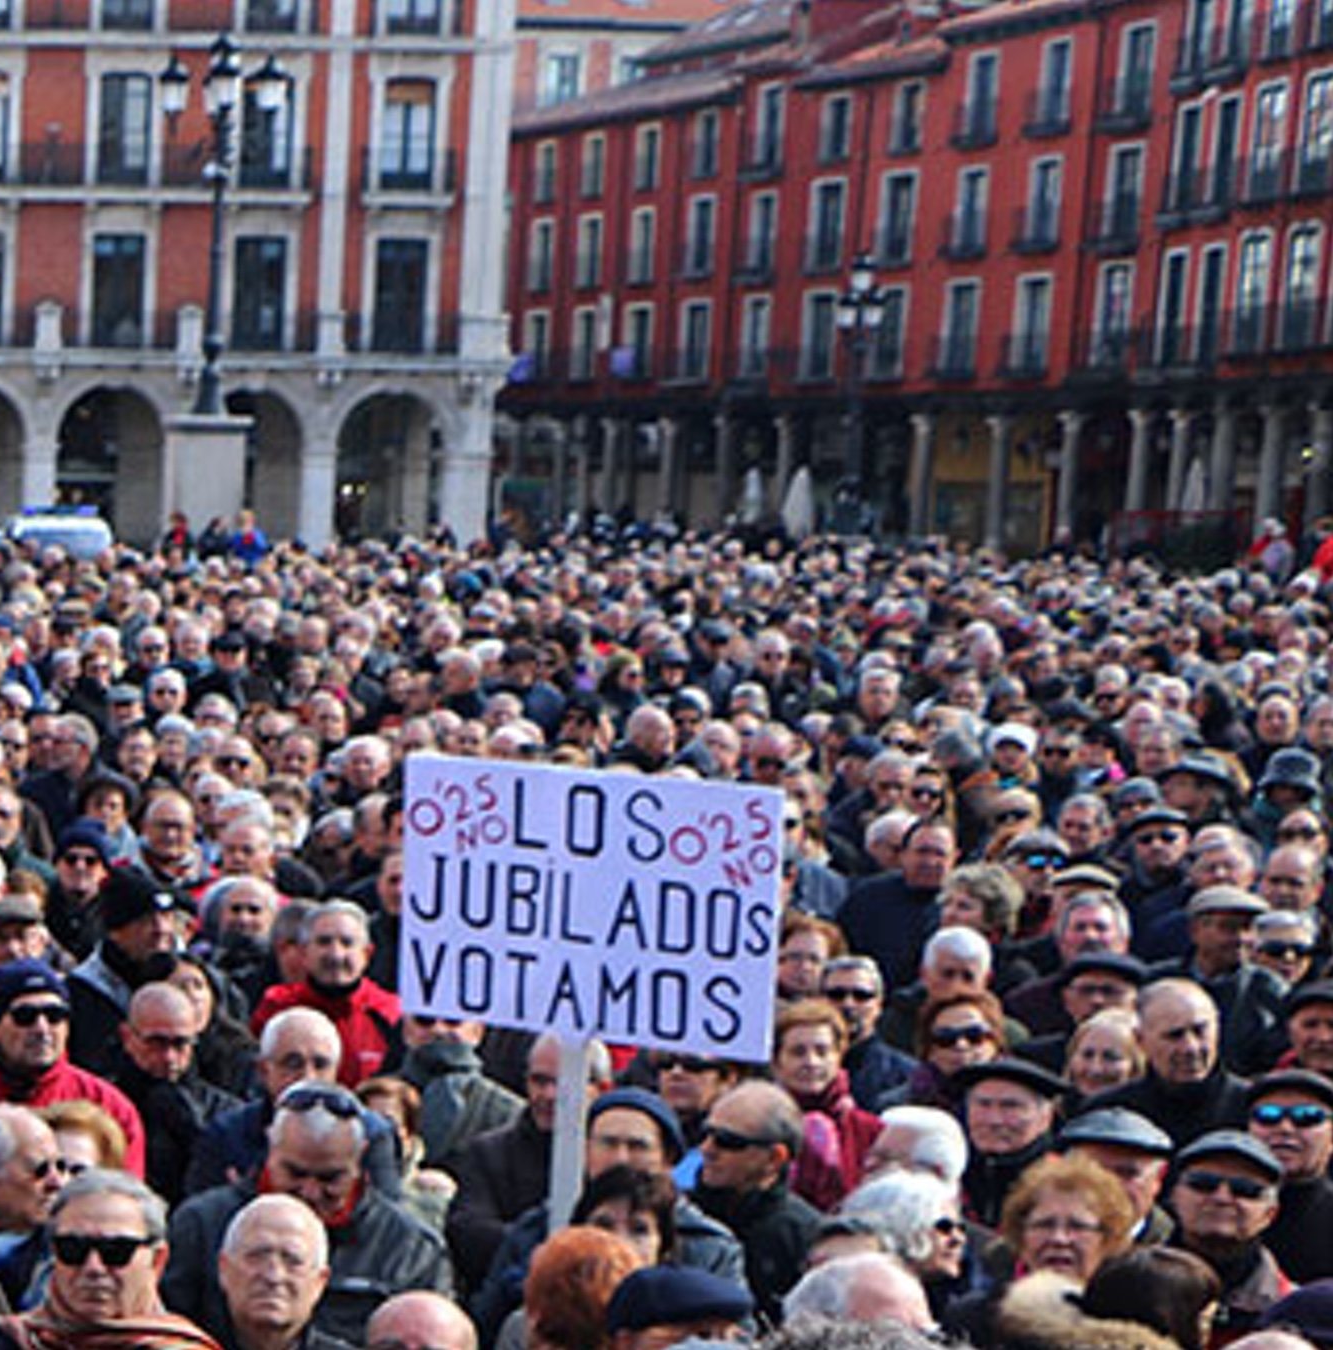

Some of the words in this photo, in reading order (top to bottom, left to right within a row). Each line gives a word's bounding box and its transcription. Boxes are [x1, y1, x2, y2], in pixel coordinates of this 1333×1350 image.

[456, 814, 508, 854] NO
[514, 777, 667, 864] LOS
[721, 844, 778, 888] NO
[410, 938, 744, 1044] VOTAMOS
